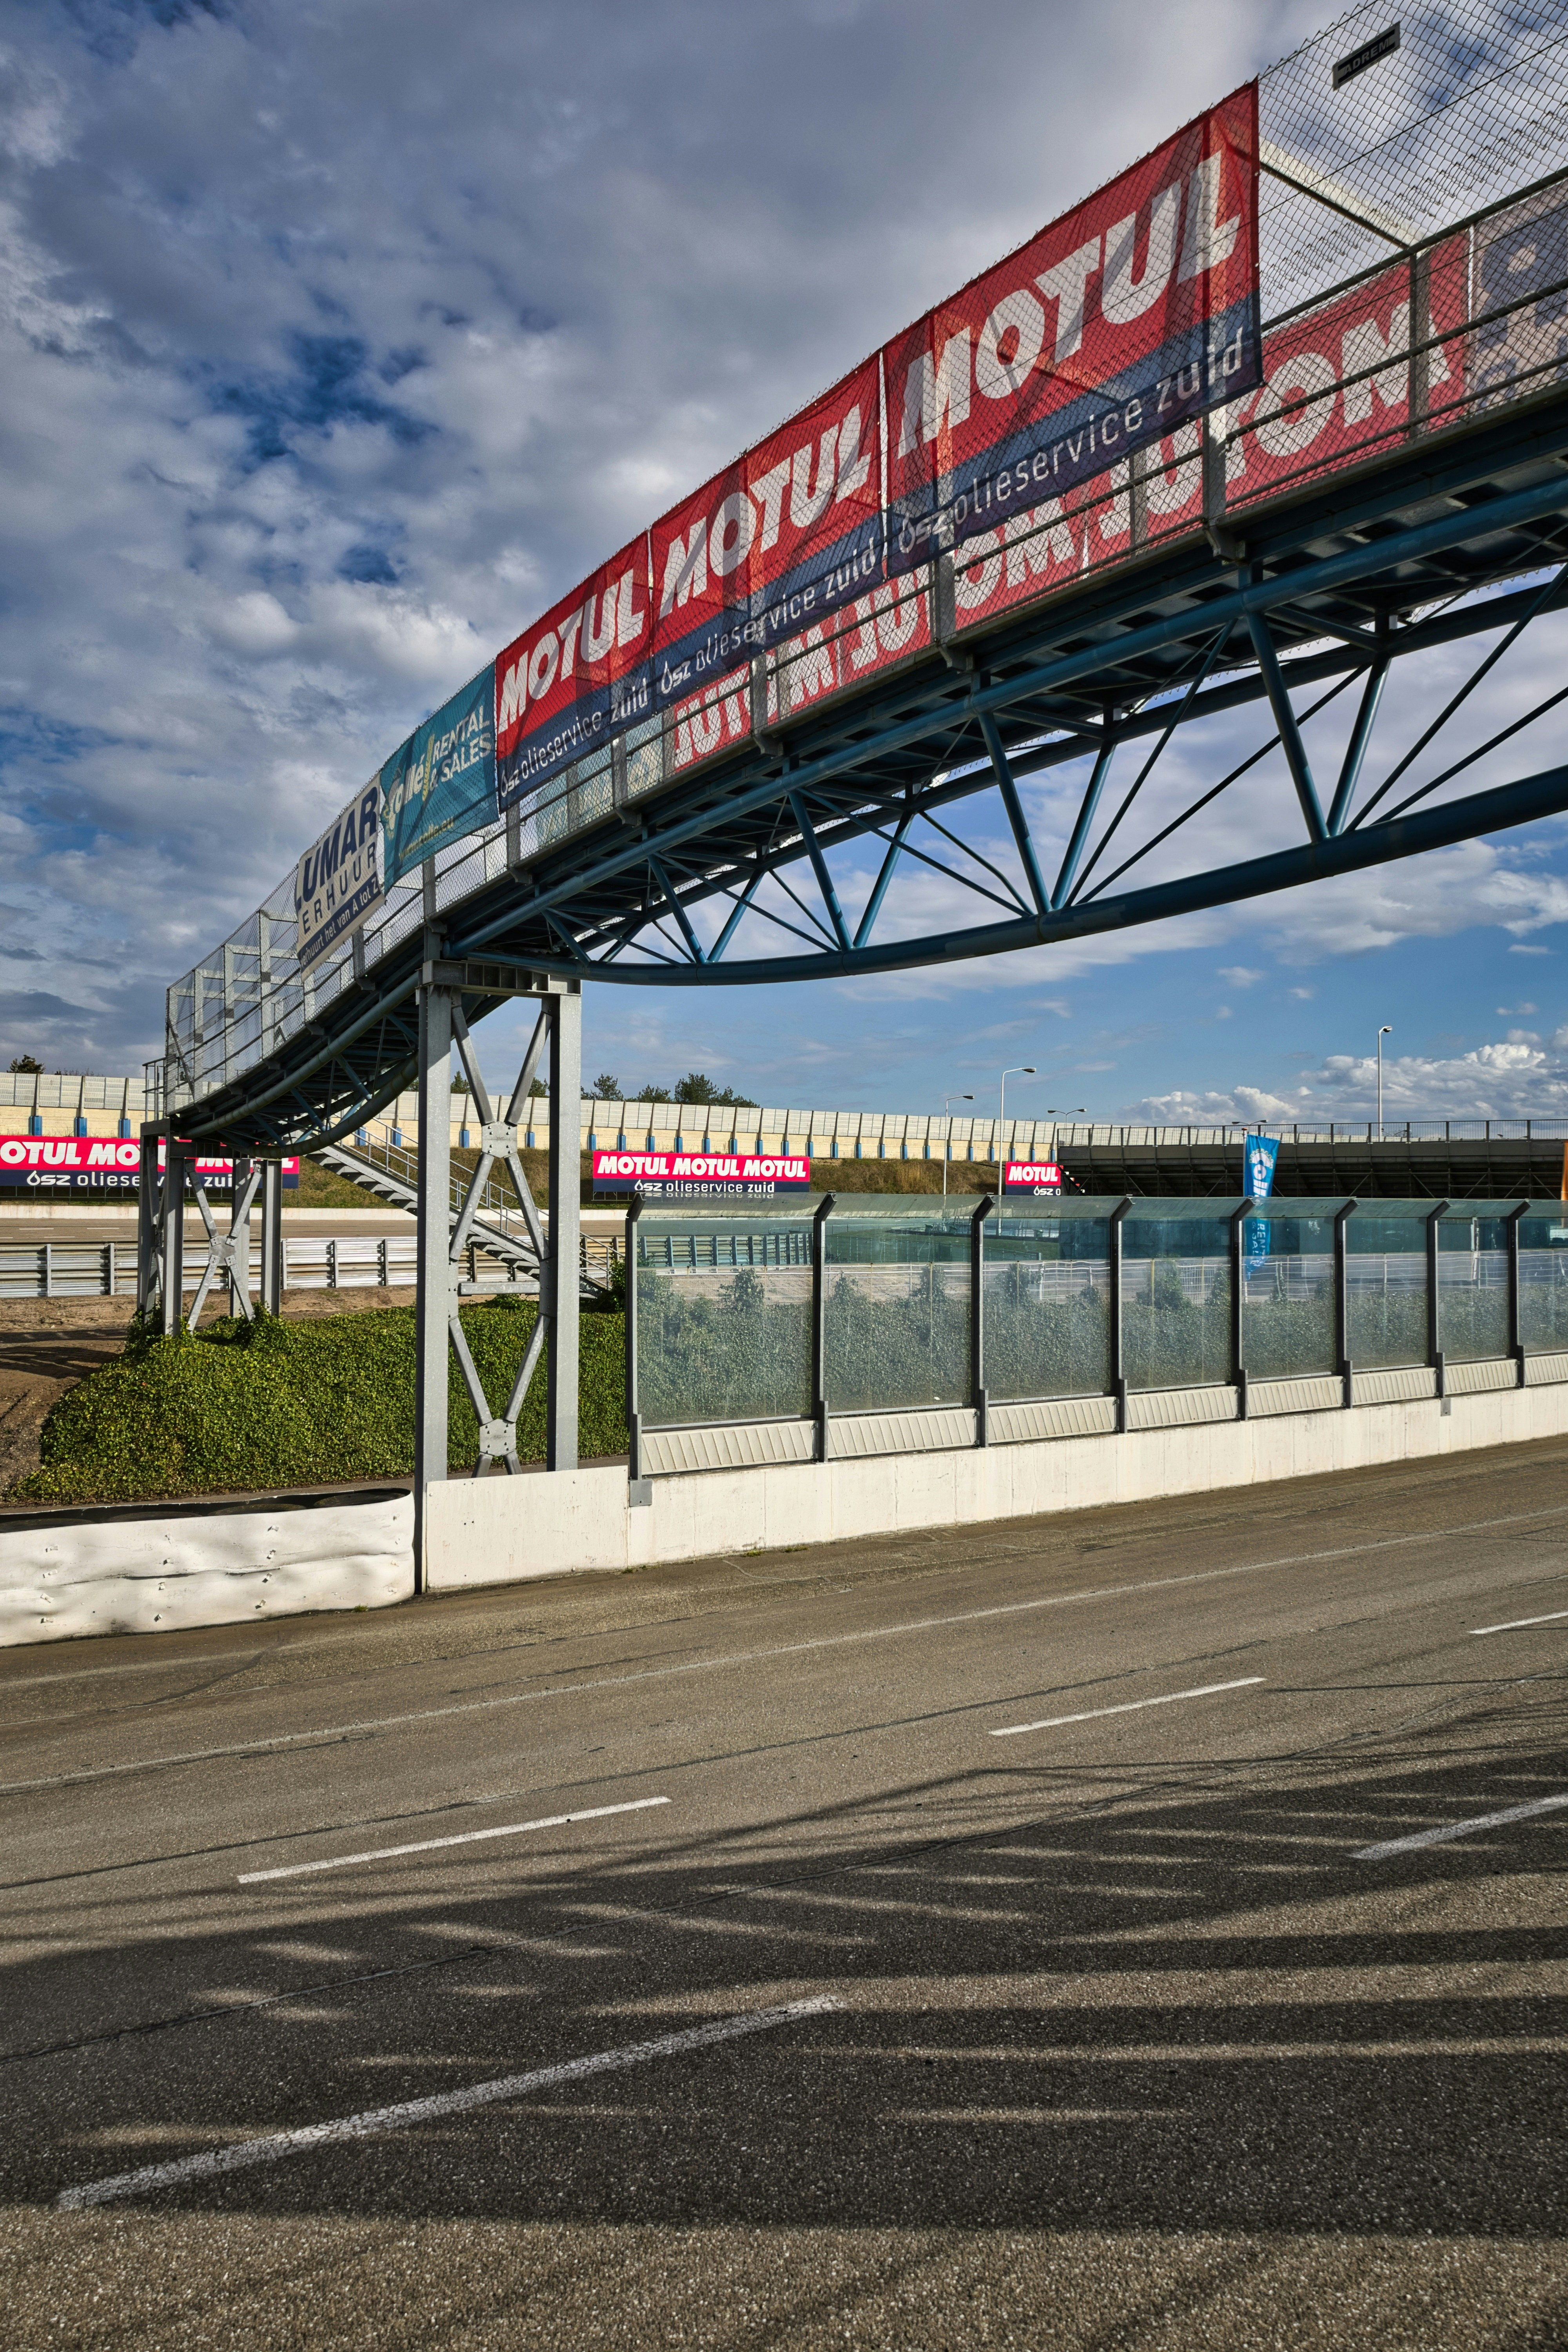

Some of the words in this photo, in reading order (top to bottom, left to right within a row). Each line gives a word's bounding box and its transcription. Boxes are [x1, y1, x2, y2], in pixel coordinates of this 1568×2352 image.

[1343, 38, 1389, 75] ADREM
[897, 151, 1241, 460] MOTUL
[954, 397, 1143, 526] olieservice
[1156, 326, 1243, 415] zuid
[658, 403, 872, 620] MOTUL
[696, 586, 816, 671] olieservice
[825, 537, 876, 600] zuid
[498, 568, 645, 734] MOTUL
[432, 705, 490, 764] RENTAL
[521, 710, 602, 779] olieservice
[610, 677, 648, 724] zuid
[430, 767, 438, 791] &
[441, 733, 491, 782] SALES
[325, 921, 338, 942] het
[337, 909, 350, 927] van
[353, 898, 358, 914] A
[360, 887, 371, 906] tot
[372, 878, 379, 894] Z
[0, 1141, 82, 1164] OTUL
[597, 1156, 670, 1174] MOTUL
[672, 1158, 740, 1176] MOTUL
[742, 1159, 806, 1178] MOTUL
[1008, 1166, 1058, 1182] MOTUL
[666, 1180, 743, 1192] olieservice
[748, 1181, 775, 1192] zuid
